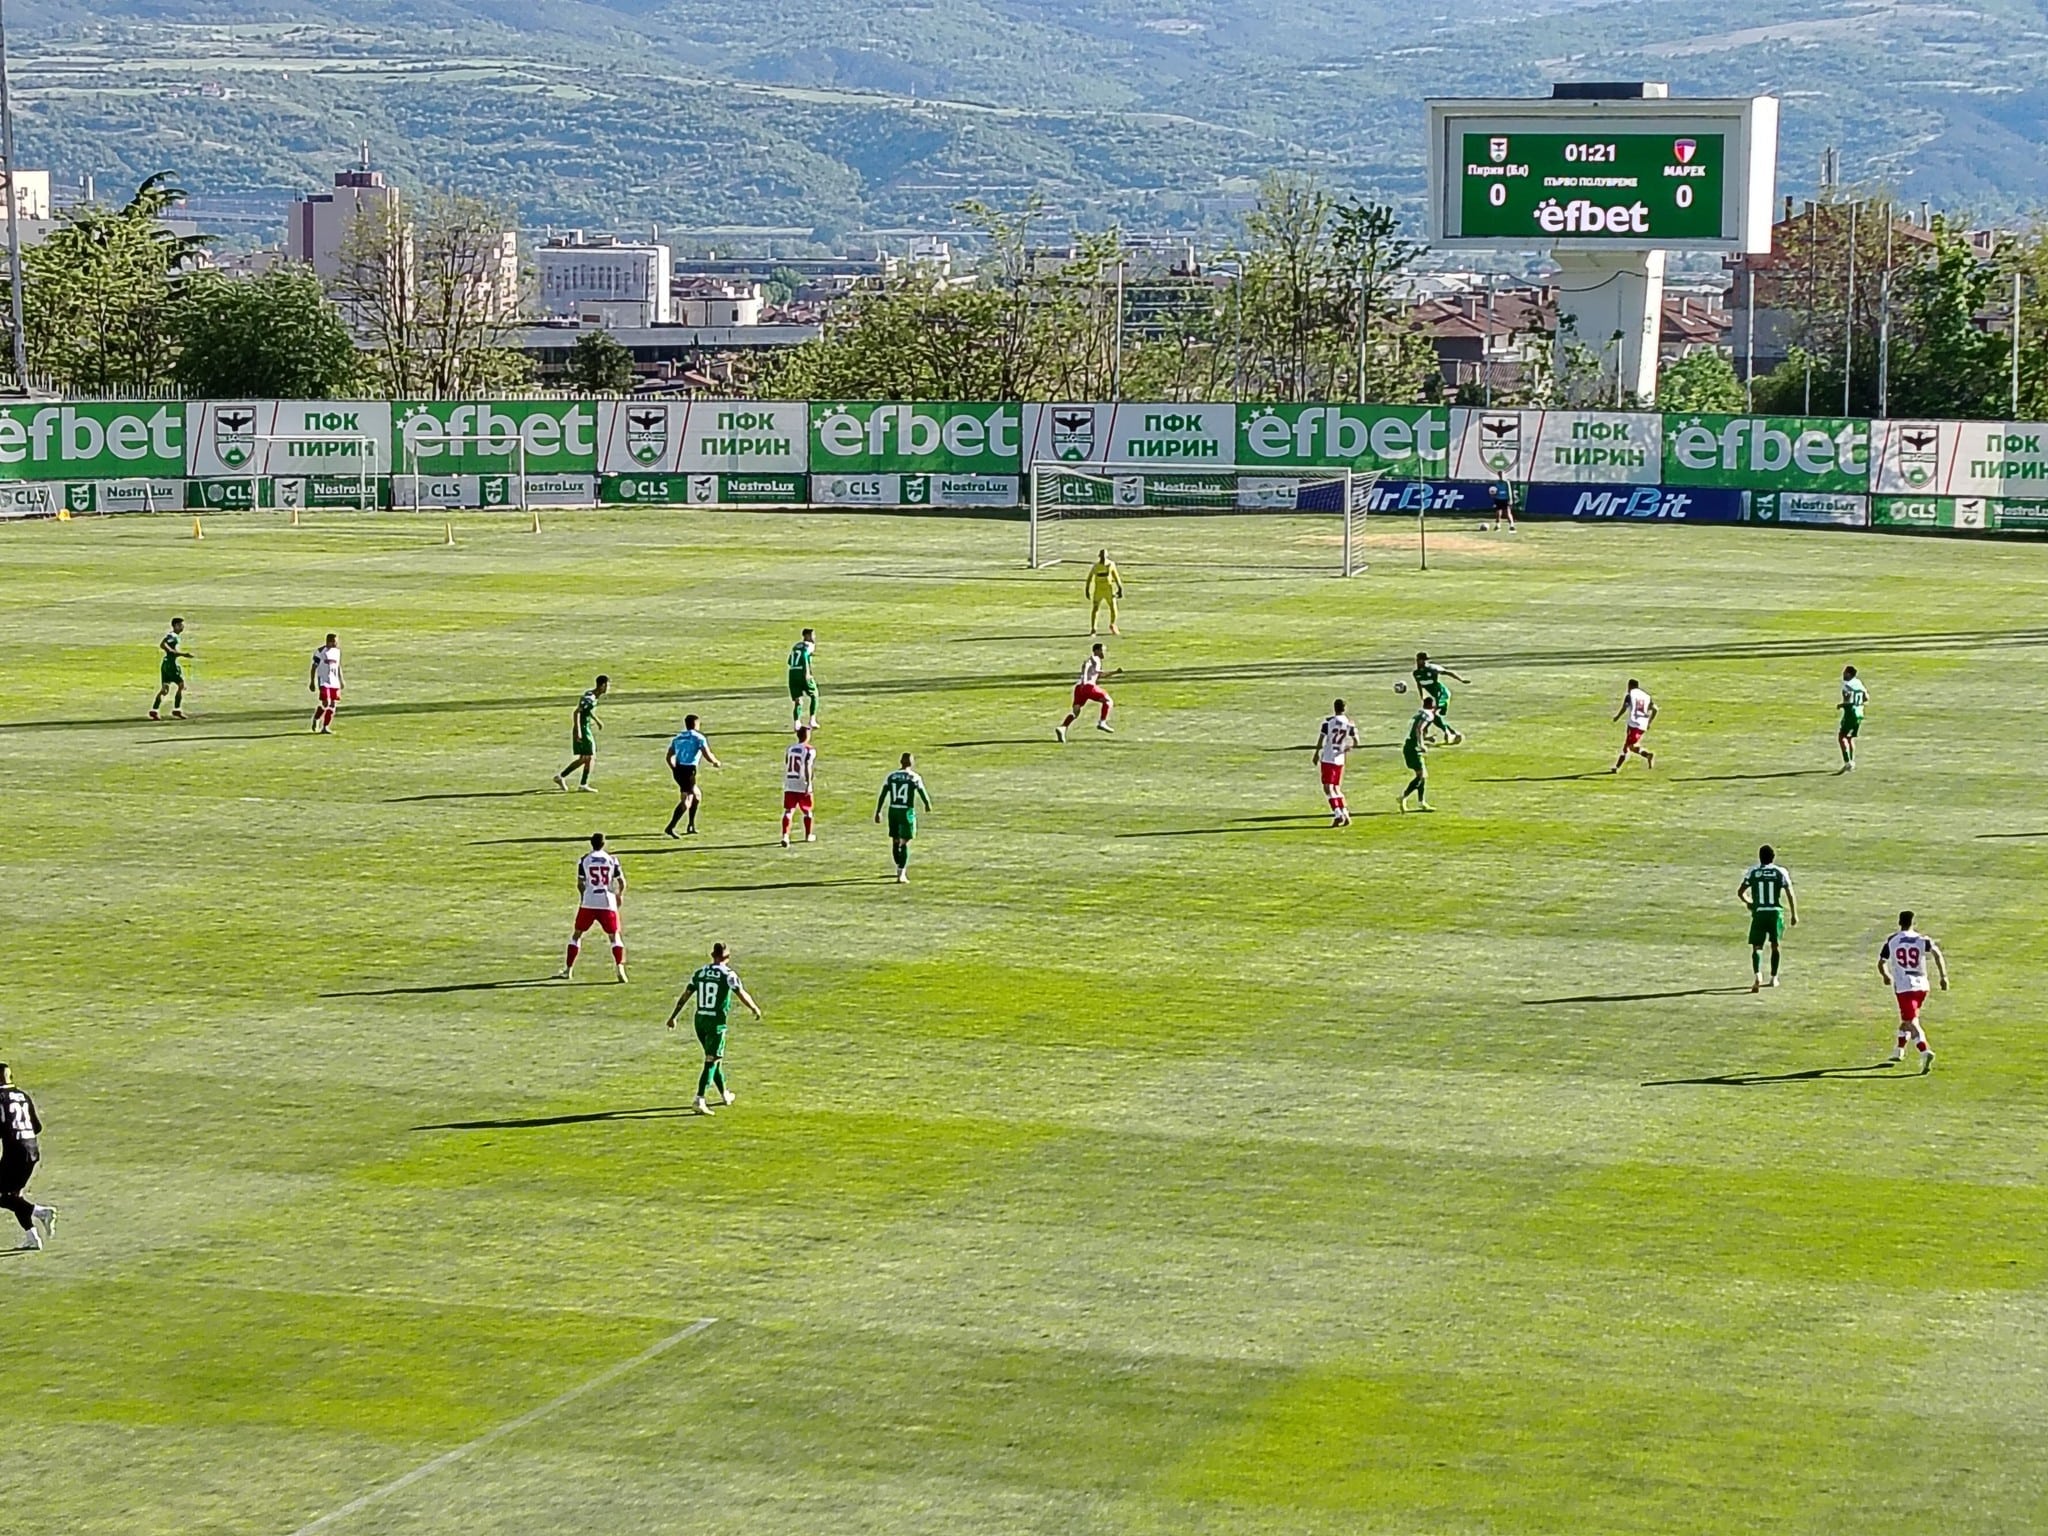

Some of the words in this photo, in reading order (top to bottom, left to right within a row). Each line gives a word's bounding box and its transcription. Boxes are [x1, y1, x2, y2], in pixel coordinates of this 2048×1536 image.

[1565, 144, 1616, 162] 01:21
[1663, 165, 1706, 177] МАРЕК
[1490, 183, 1506, 206] 0
[1676, 184, 1693, 208] 0
[1540, 200, 1649, 233] efbet
[304, 412, 359, 431] ПФК
[404, 404, 593, 458] efbet
[718, 412, 775, 431] ПФК
[820, 405, 1018, 457] efbet
[1145, 414, 1202, 432] ПФК
[1248, 407, 1446, 461] efbet
[1572, 422, 1630, 441] ПФК
[701, 438, 790, 456] ПИРИН
[1128, 439, 1218, 457] ПИРИН
[1675, 419, 1868, 475] efbet
[1986, 434, 2040, 453] ПФК
[1555, 447, 1645, 467] ПИРИН
[431, 484, 460, 497] CLS
[637, 481, 668, 496] CLS
[728, 480, 794, 491] NostroLux
[850, 482, 880, 495] CLS
[941, 480, 1008, 492] NostroLux
[1573, 487, 1692, 518] MrBit
[891, 782, 909, 804] 14
[1758, 881, 1775, 905] 11
[1896, 947, 1920, 969] 99
[699, 981, 719, 1009] 18
[9, 1102, 33, 1130] 21
